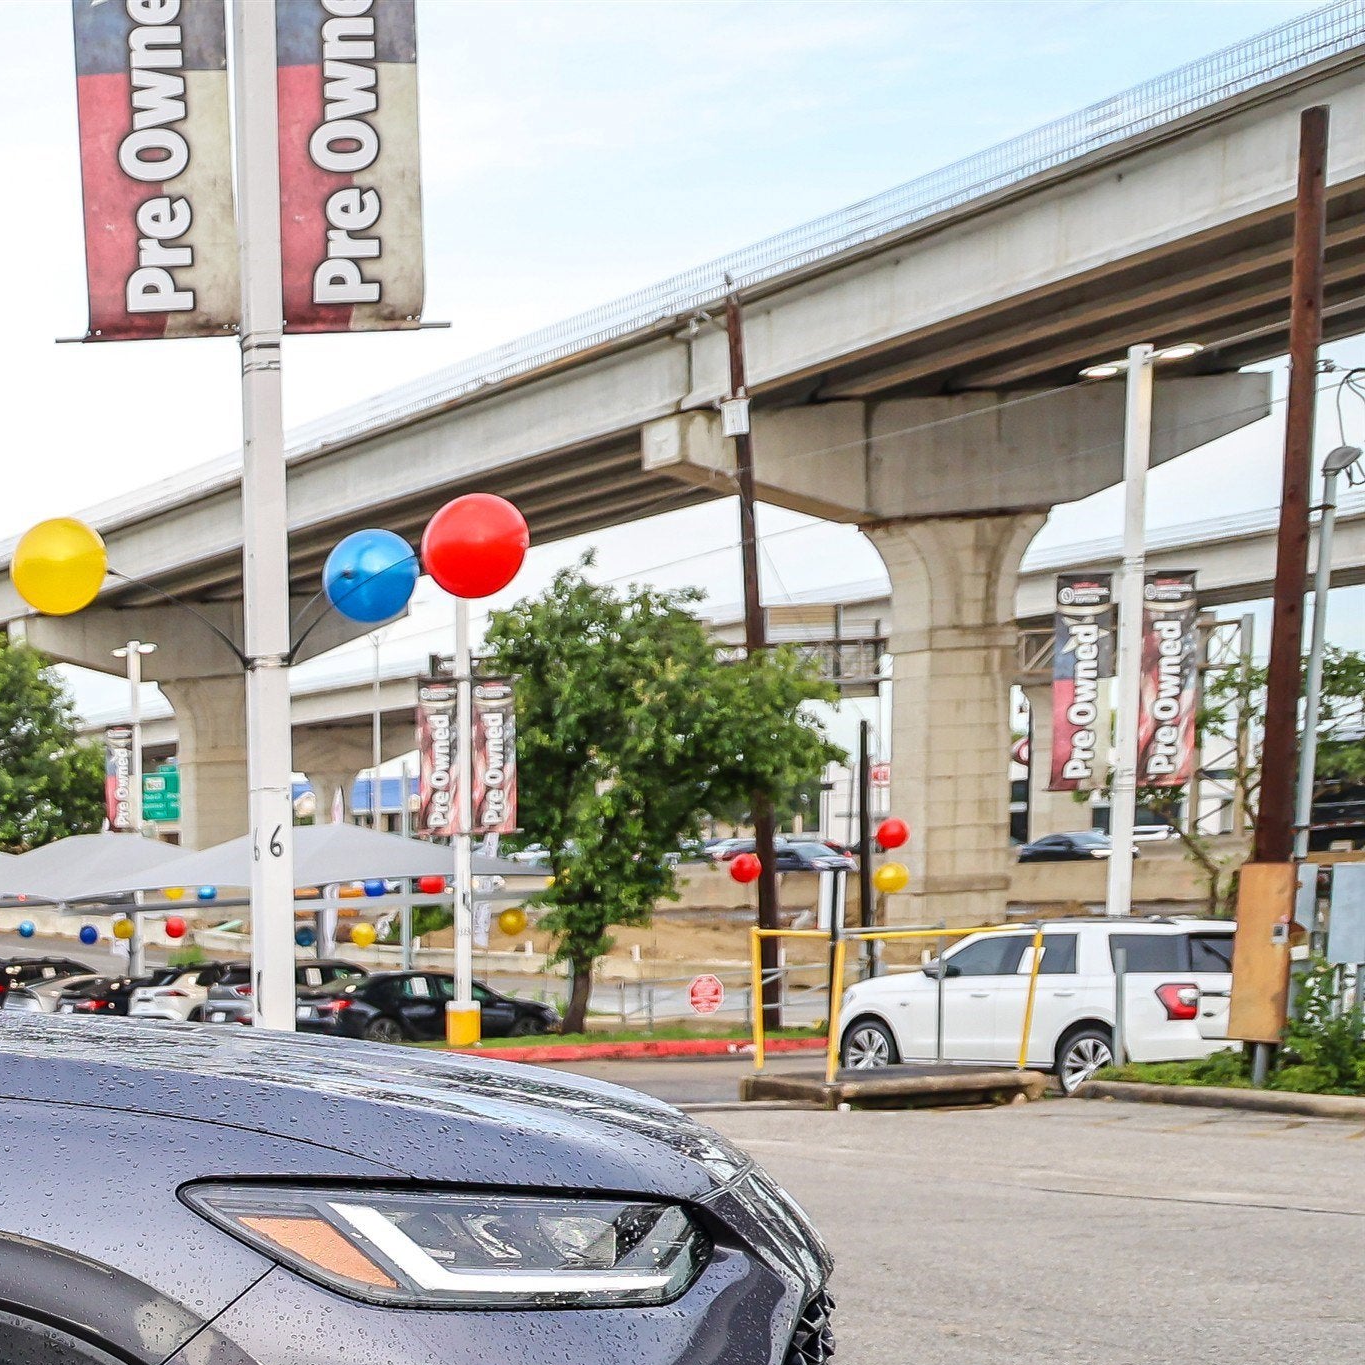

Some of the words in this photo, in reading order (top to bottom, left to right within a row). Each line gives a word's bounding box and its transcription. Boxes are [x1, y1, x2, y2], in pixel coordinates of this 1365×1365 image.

[126, 197, 194, 313] Pre
[313, 188, 381, 304] Pre
[1067, 624, 1099, 726] Owned
[1152, 620, 1183, 721] Owned
[427, 714, 451, 790] Owned
[480, 712, 505, 788] Owned
[1063, 729, 1096, 780] Pre
[1147, 726, 1179, 775] Pre
[270, 824, 283, 858] 6
[427, 790, 450, 828] Pre
[481, 788, 505, 826] Pre
